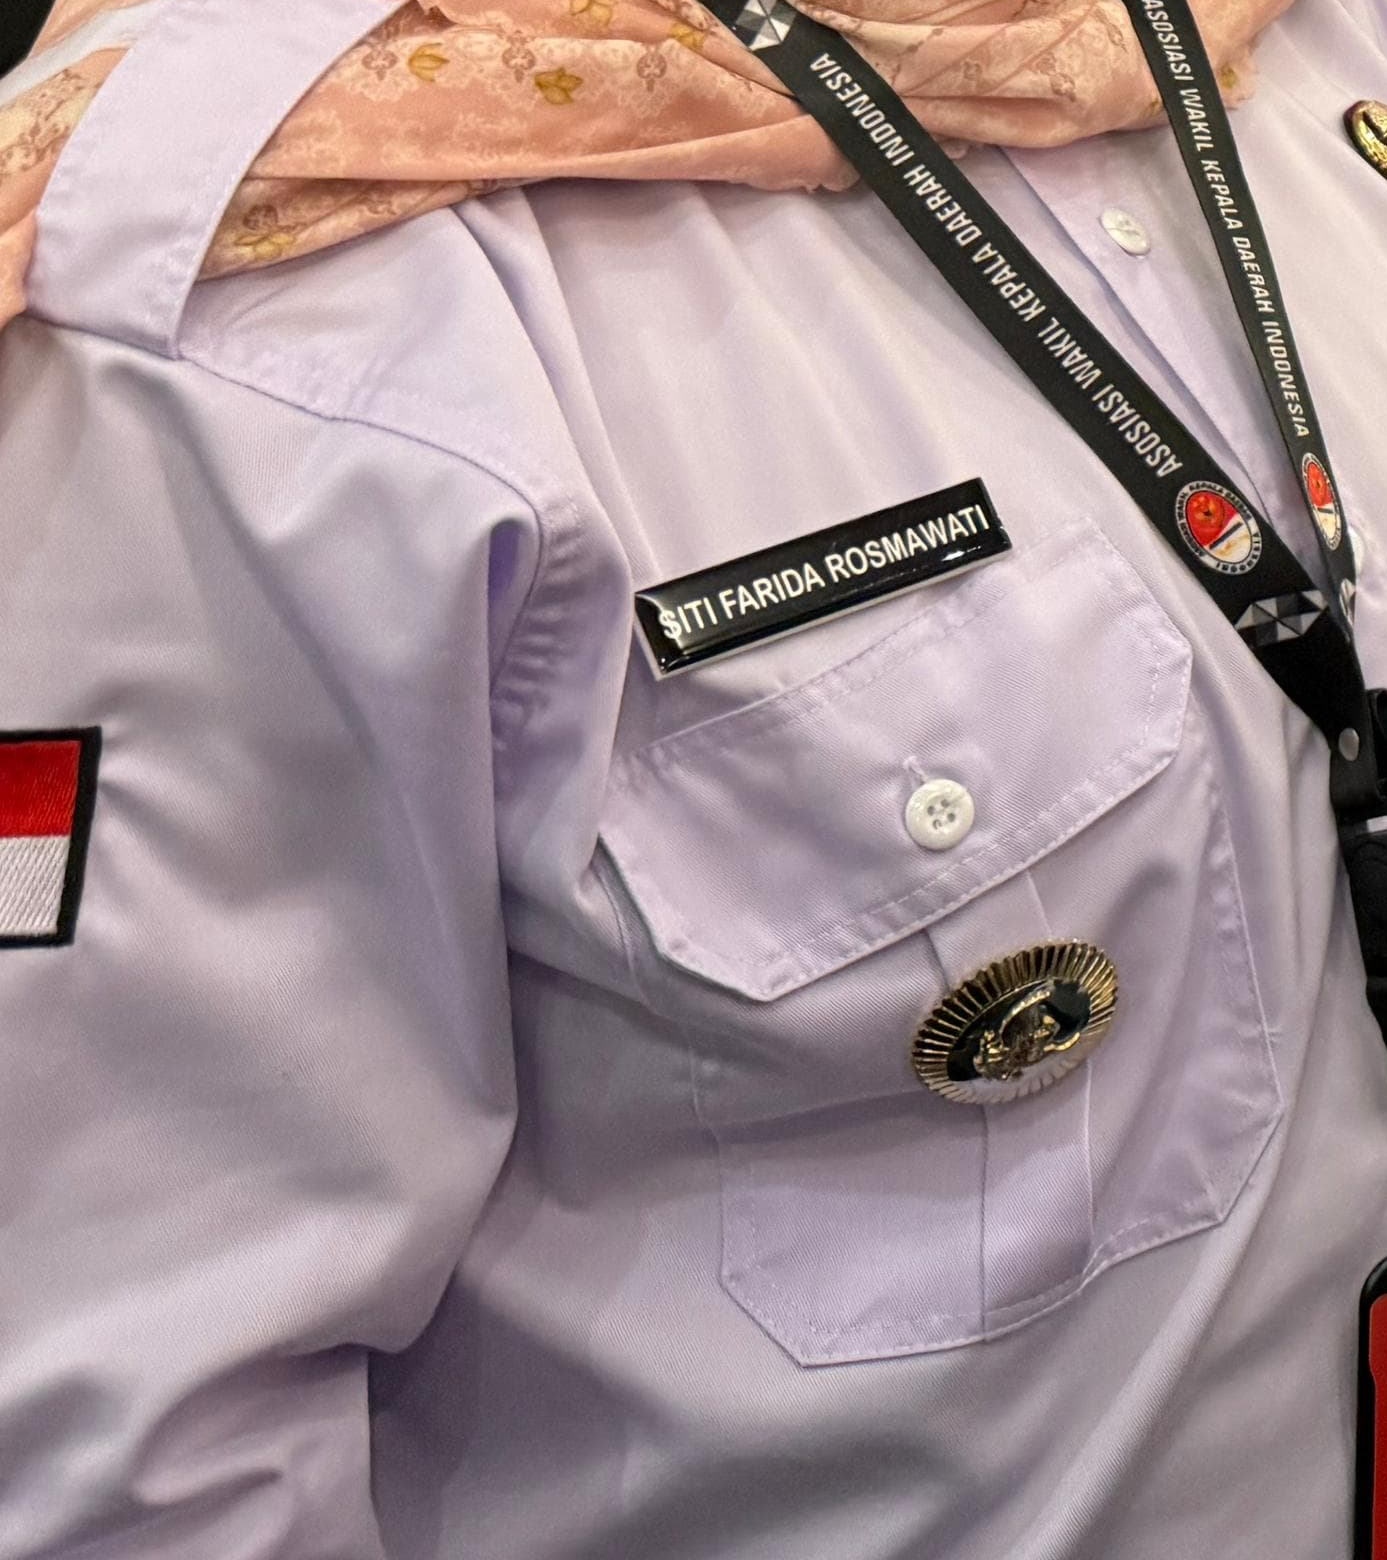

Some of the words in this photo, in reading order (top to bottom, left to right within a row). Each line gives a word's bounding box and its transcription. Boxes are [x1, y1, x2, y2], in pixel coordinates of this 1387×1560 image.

[809, 52, 915, 167] INDONESIA
[903, 164, 983, 247] DAERAH
[971, 242, 1046, 322] KEPALA
[1180, 88, 1214, 152] WAKIL
[1201, 159, 1244, 230] KEPALA
[1232, 236, 1276, 313] DAERAH
[1262, 321, 1310, 437] INDONESIA
[1038, 316, 1102, 390] WAKIL
[1091, 383, 1184, 478] ASOSIASI
[659, 597, 718, 640] SITI
[718, 562, 826, 620] FARIDA
[824, 504, 991, 583] ROSMAWATI
